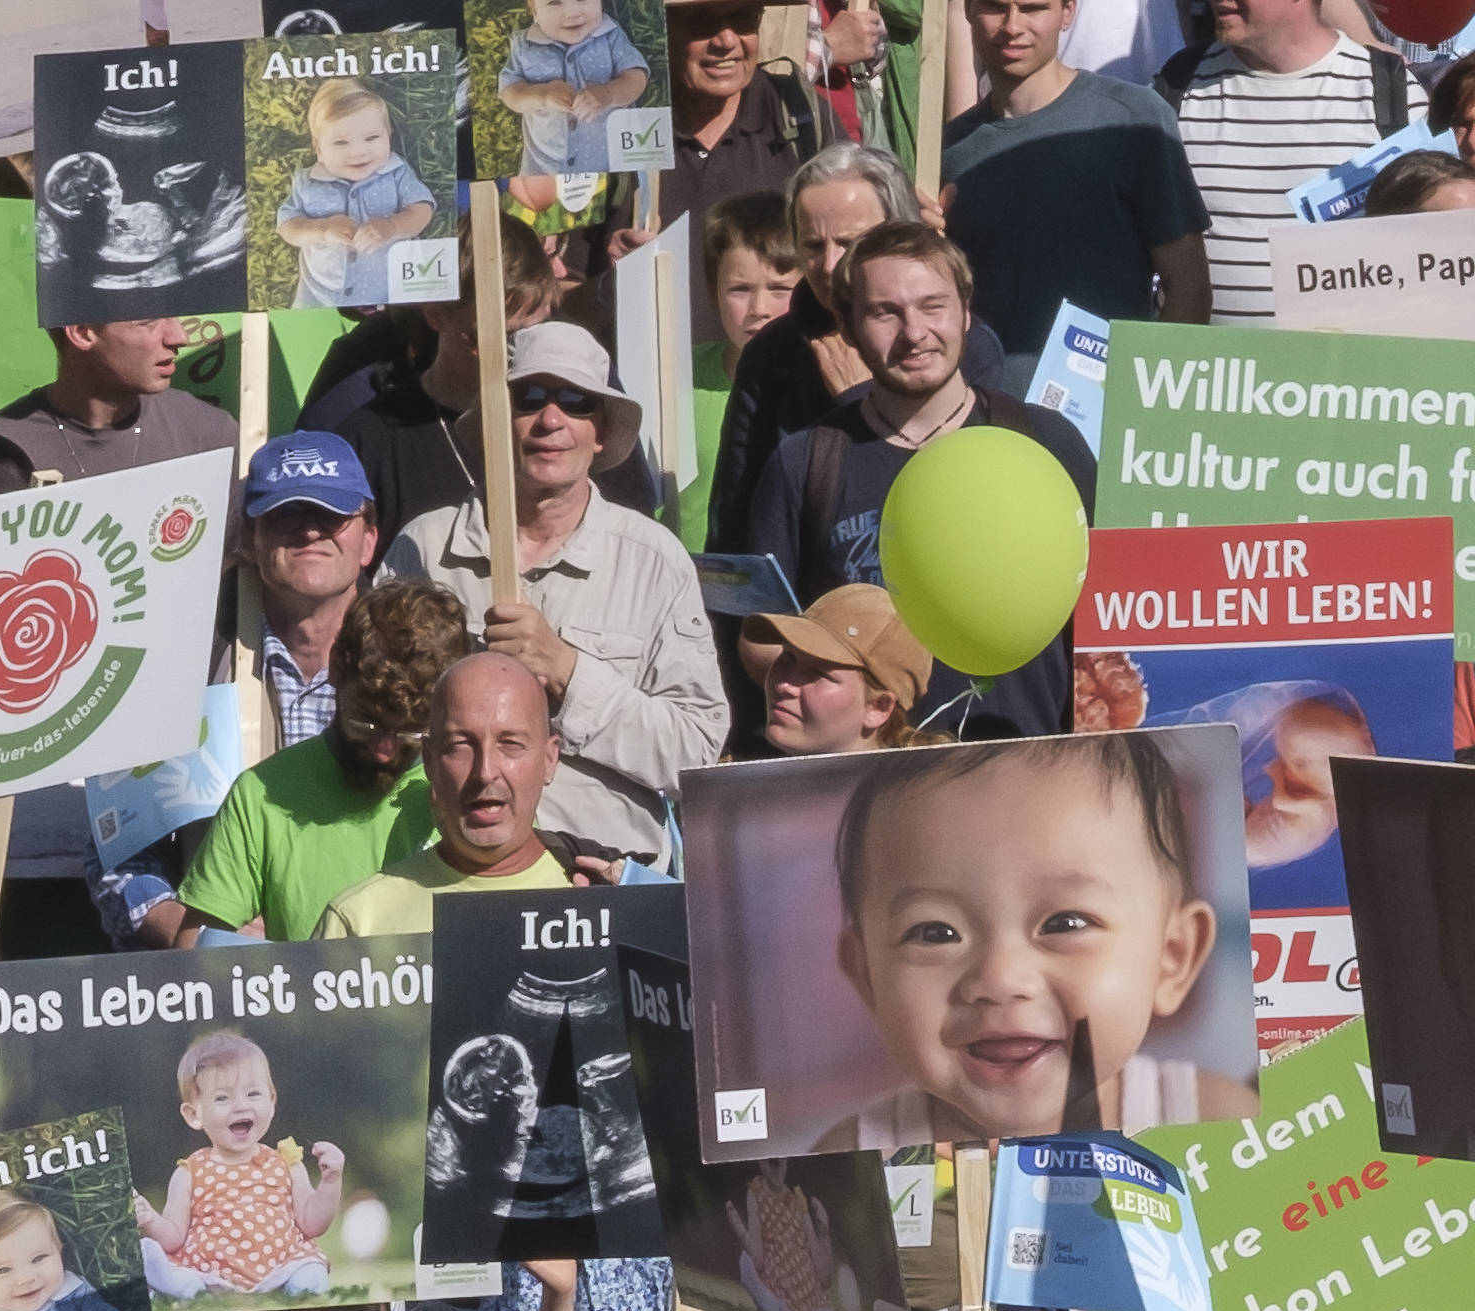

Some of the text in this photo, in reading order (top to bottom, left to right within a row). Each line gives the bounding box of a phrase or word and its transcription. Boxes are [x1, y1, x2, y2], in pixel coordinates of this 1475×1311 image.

[104, 60, 179, 92] Ich!
[263, 43, 441, 82] Auch ich!
[1296, 260, 1406, 295] Danke,
[1120, 431, 1280, 495] kultur
[1296, 442, 1427, 502] auch
[2, 499, 82, 544] YOU
[82, 513, 146, 623] MOM!
[1223, 539, 1308, 580] WIR
[1094, 579, 1433, 631] WOLLEN LEBEN!
[1229, 1091, 1347, 1170] dem
[1281, 1158, 1390, 1234] eine
